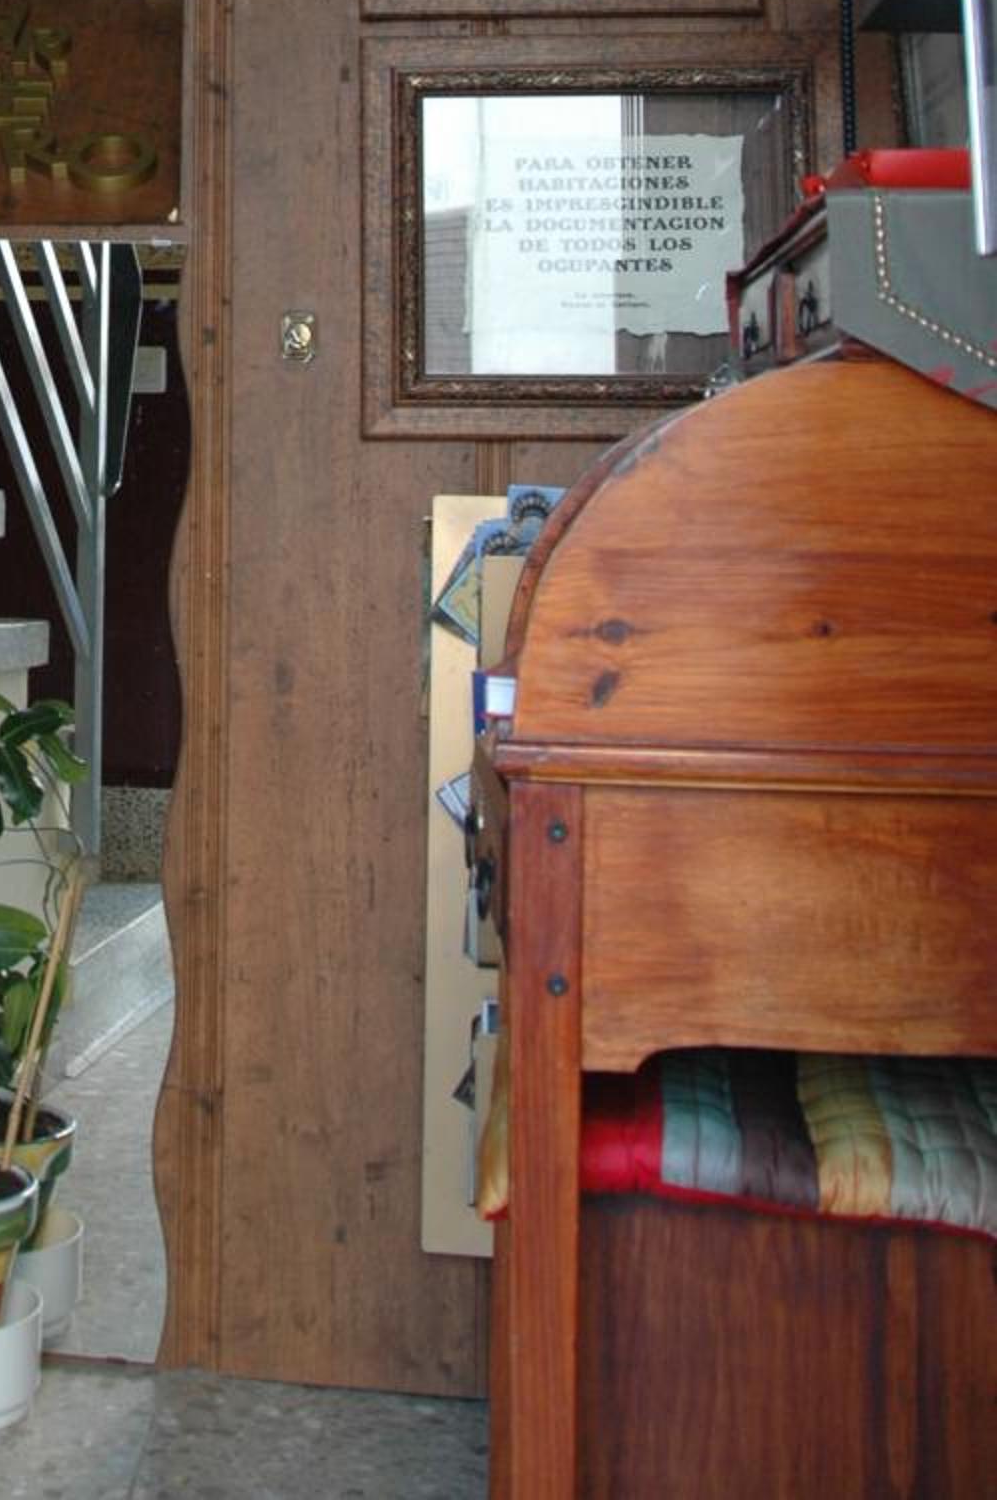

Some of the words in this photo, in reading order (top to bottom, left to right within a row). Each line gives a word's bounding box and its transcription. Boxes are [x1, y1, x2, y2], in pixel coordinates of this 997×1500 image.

[515, 157, 574, 172] PARA
[586, 155, 692, 170] OBTENER
[519, 176, 690, 192] HABITACIONES
[486, 198, 513, 212] ES
[526, 196, 724, 211] IMPRESCINDIBLE
[485, 218, 513, 232] LA
[526, 217, 725, 232] DOCUMENTACION
[519, 238, 549, 253] DE
[559, 237, 636, 253] TODOS
[649, 236, 693, 251] LOS
[538, 258, 673, 273] OCUPANTES
